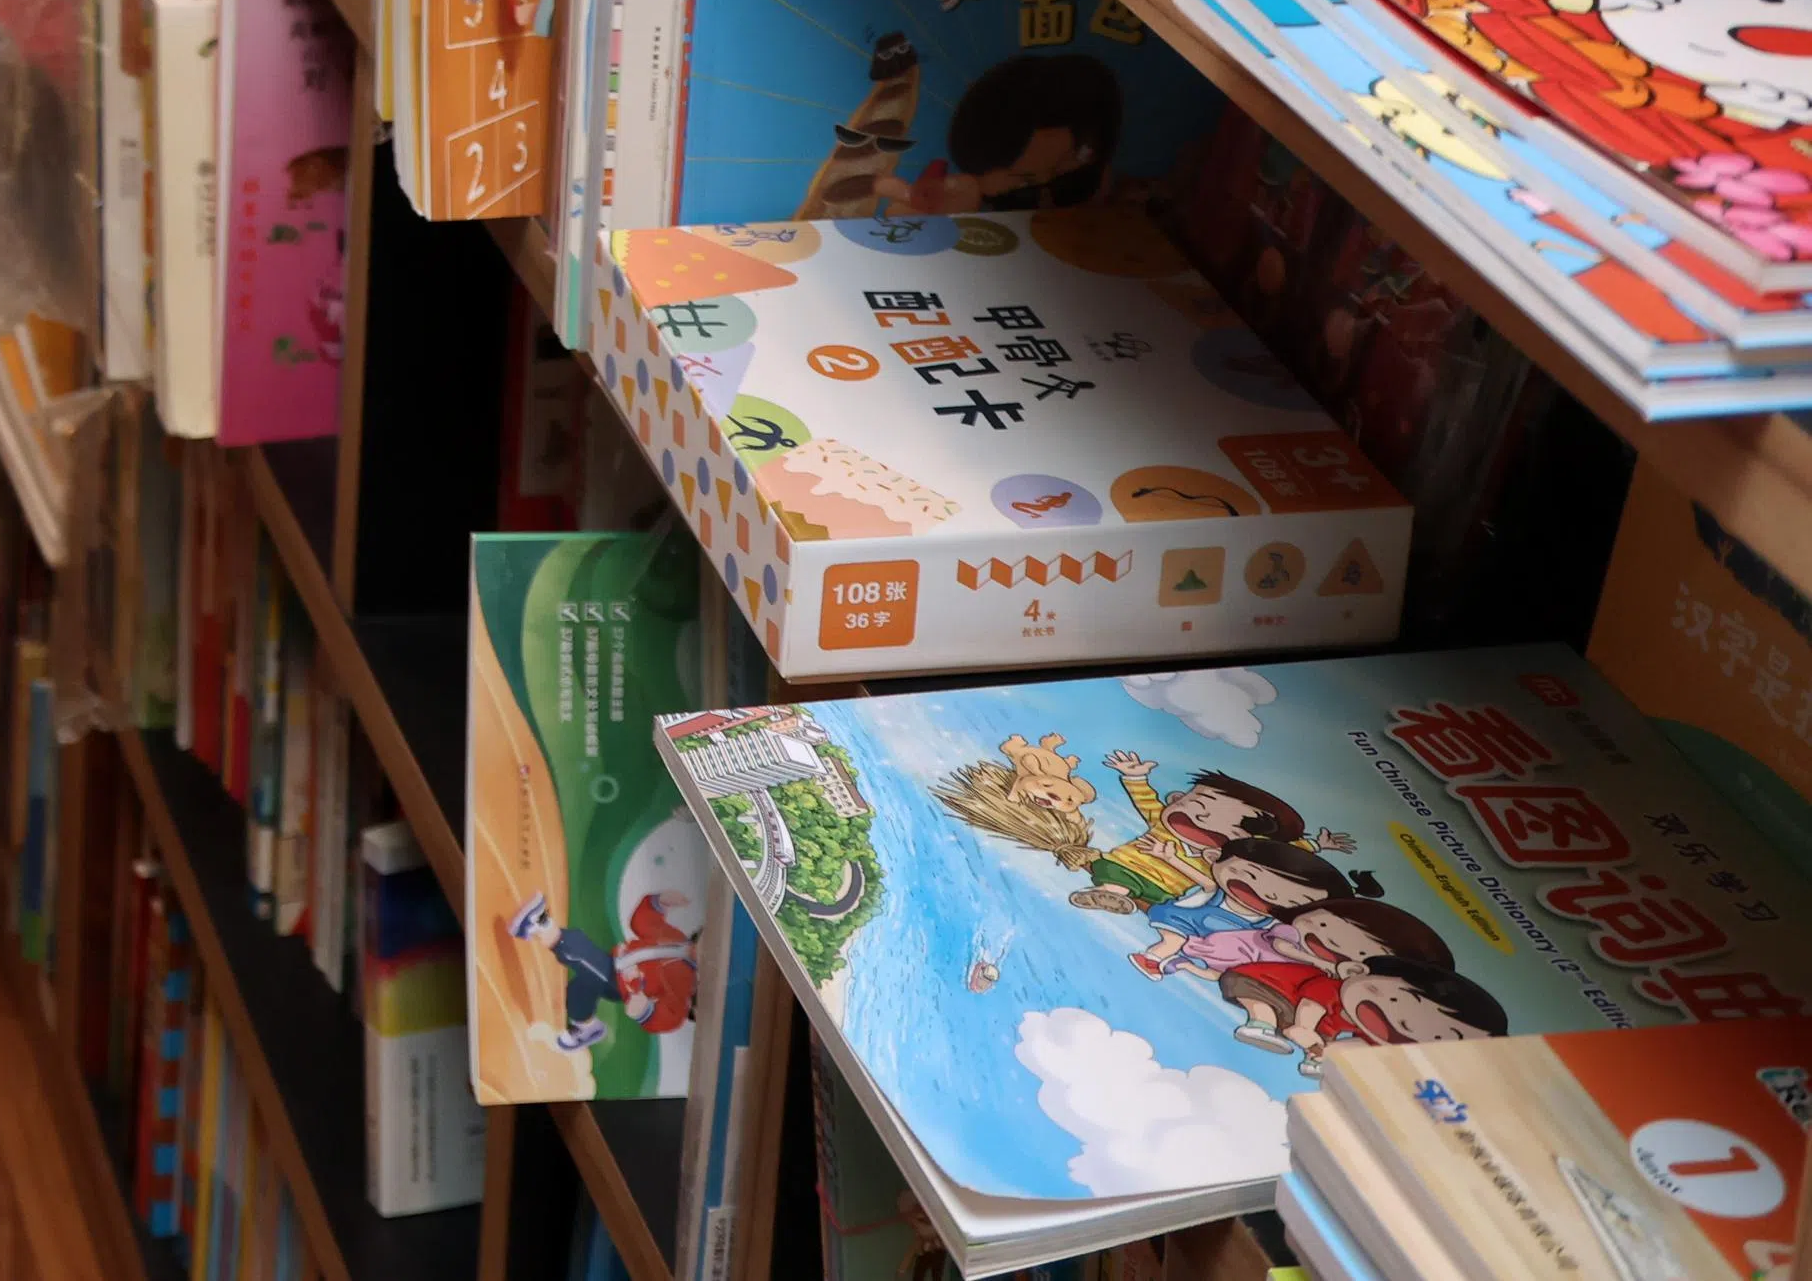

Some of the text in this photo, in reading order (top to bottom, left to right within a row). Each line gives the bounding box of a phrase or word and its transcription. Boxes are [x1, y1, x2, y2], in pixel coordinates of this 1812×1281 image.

[489, 57, 508, 110] 4
[466, 139, 486, 206] 2
[819, 351, 870, 374] 2
[862, 290, 1026, 431] 配配卡
[973, 305, 1096, 402] 甲骨文
[1348, 729, 1378, 757] Fun
[1375, 758, 1432, 818] Chinese
[1429, 820, 1482, 875] Picture
[1477, 875, 1556, 955] Dictionary
